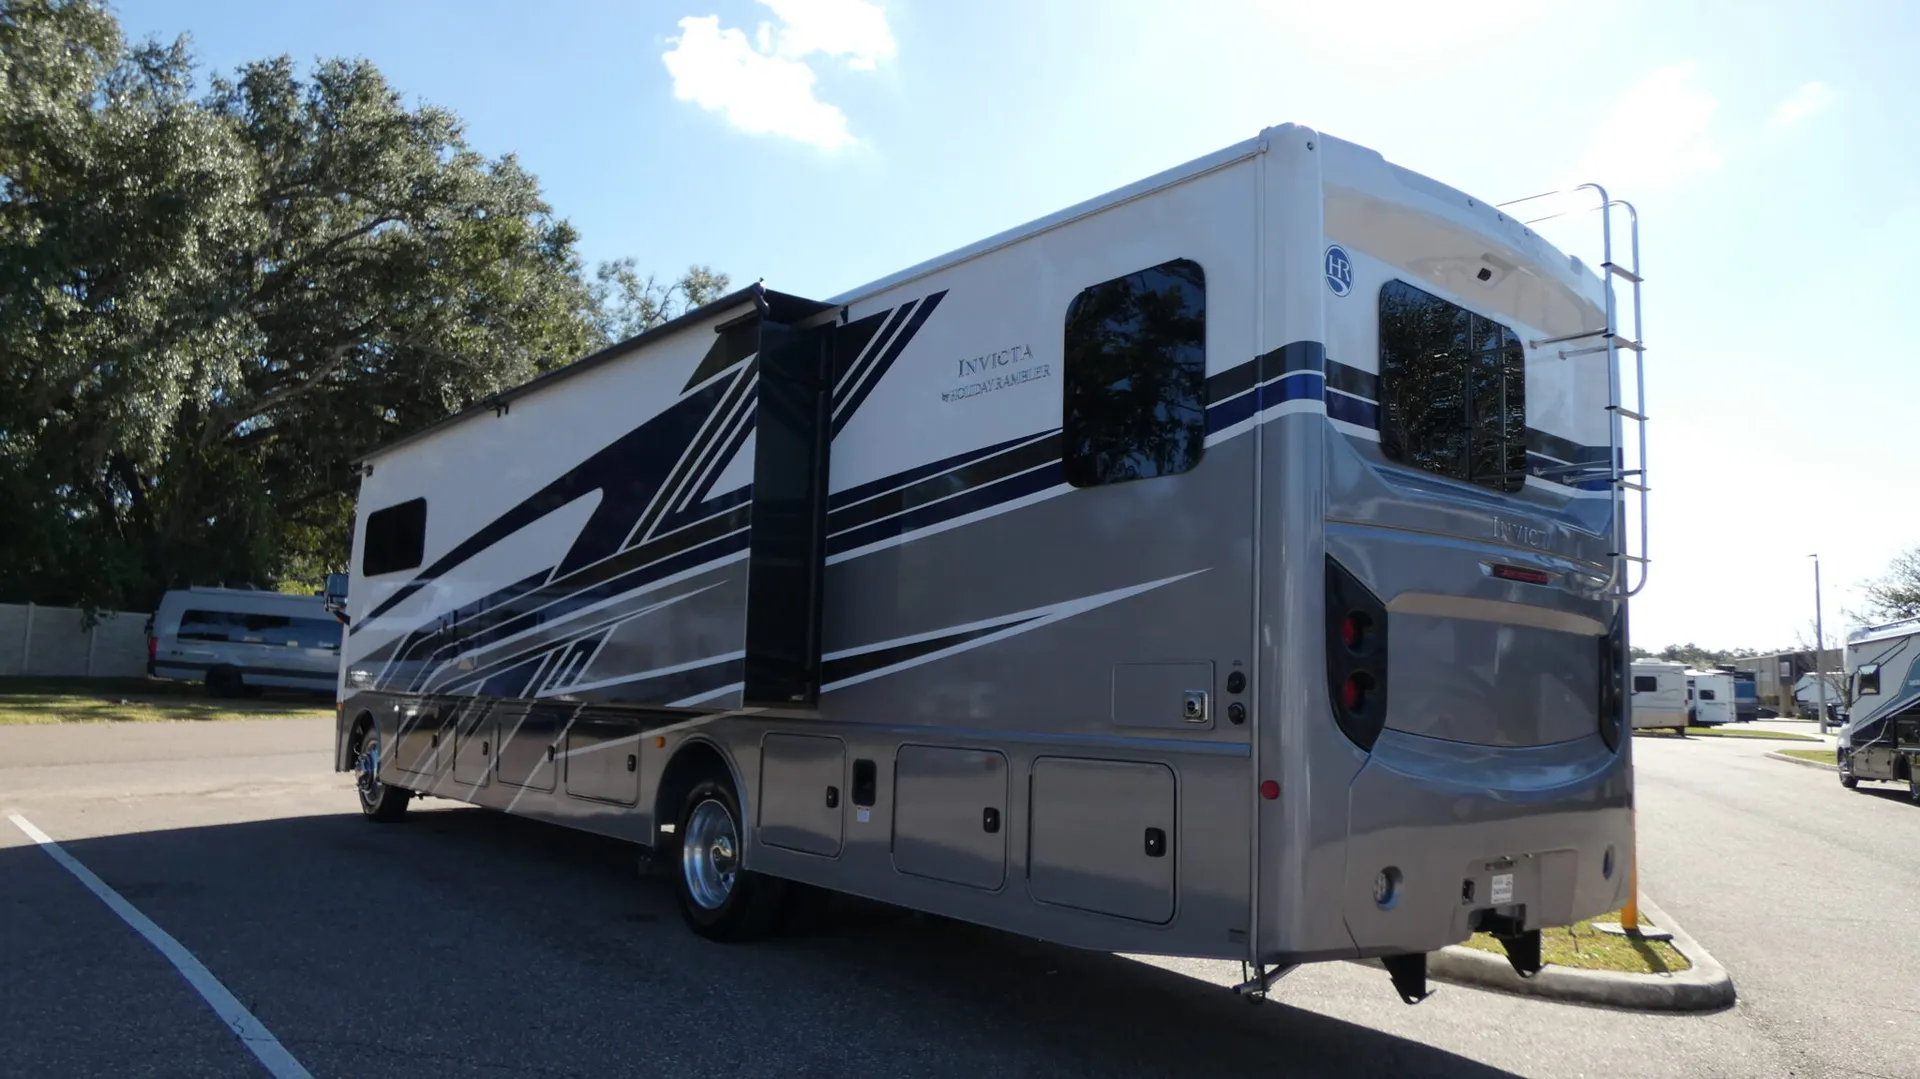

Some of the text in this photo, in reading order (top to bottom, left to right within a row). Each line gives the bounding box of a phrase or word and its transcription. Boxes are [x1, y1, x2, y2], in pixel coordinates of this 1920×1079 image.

[1328, 254, 1350, 282] HR
[958, 343, 1034, 379] INVICTA
[1493, 516, 1551, 550] INVICT
